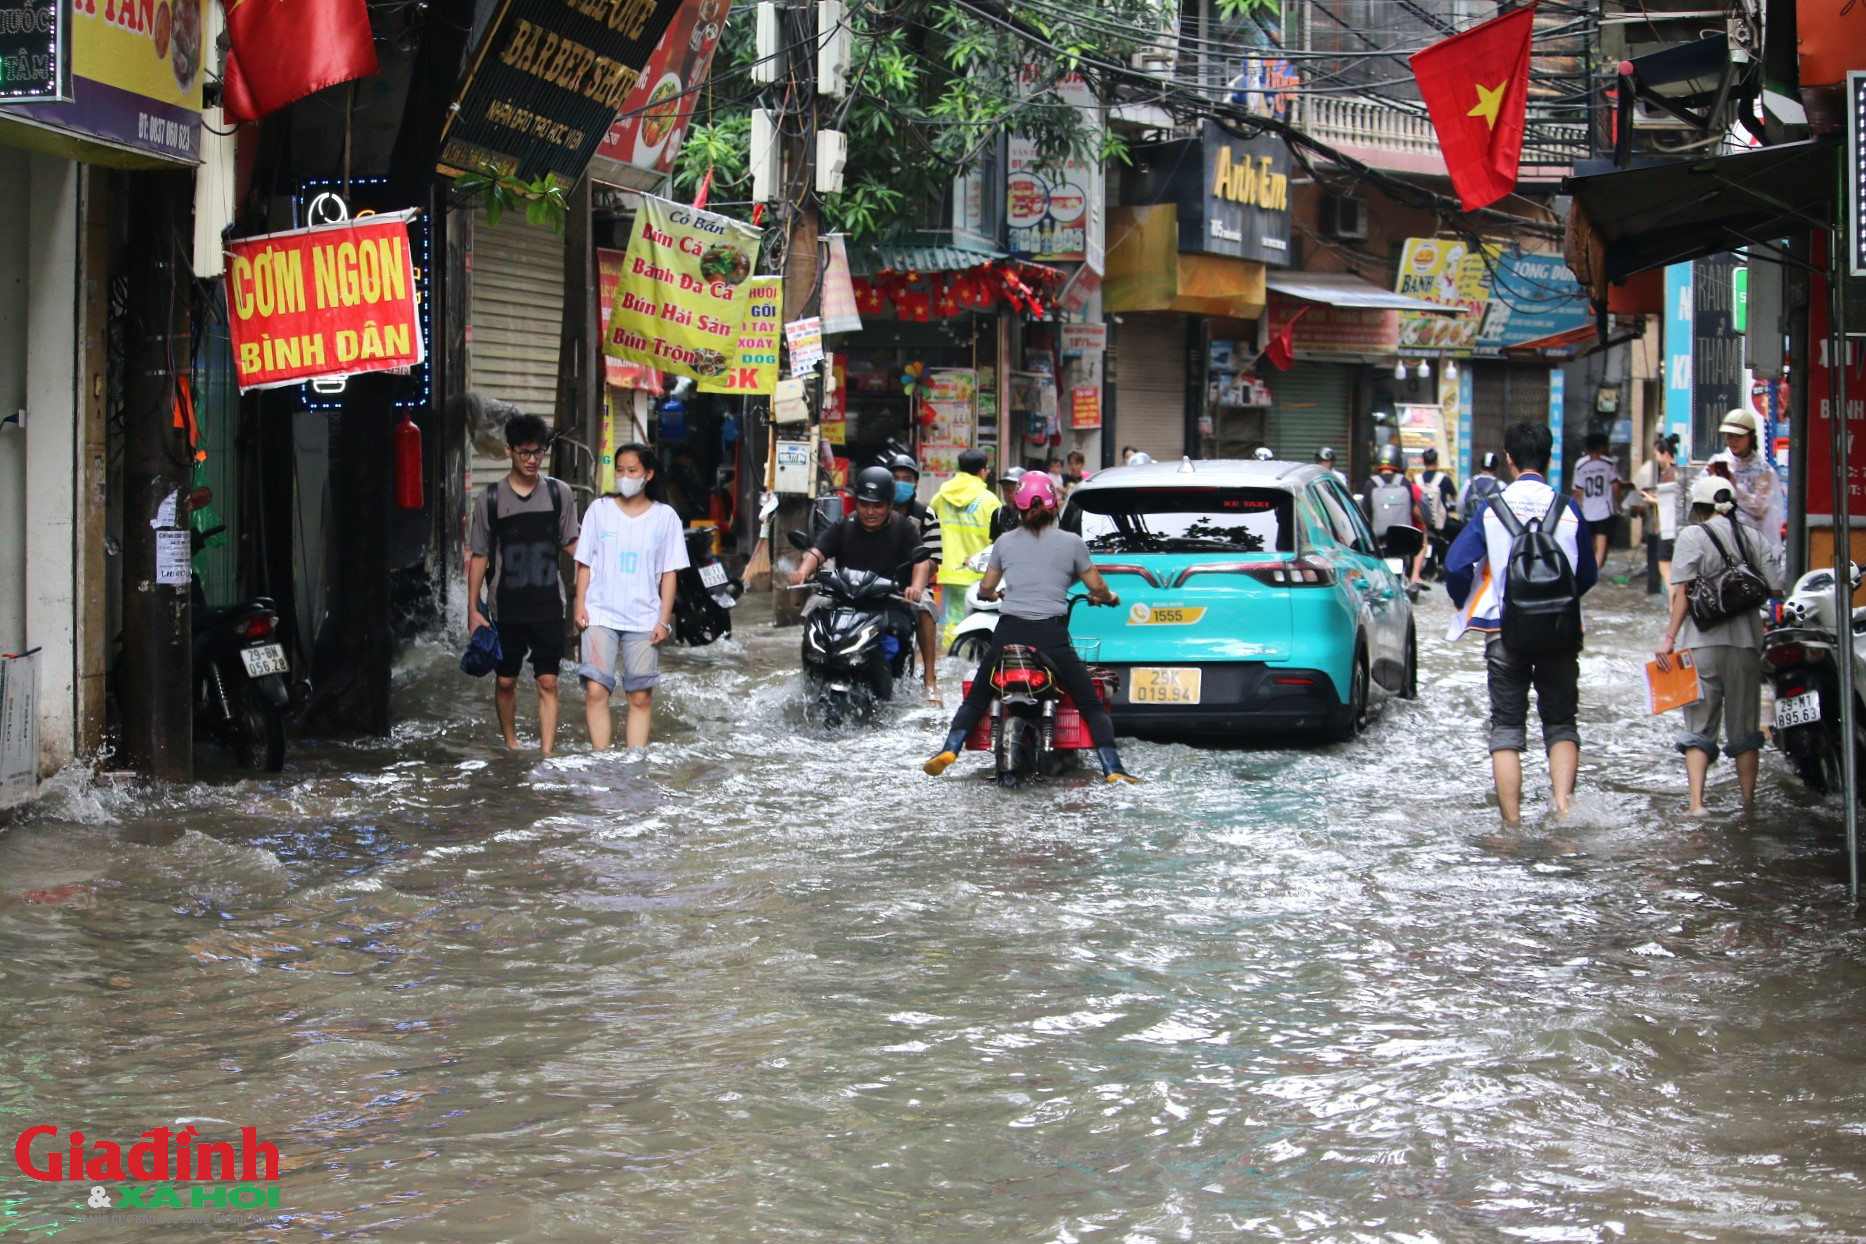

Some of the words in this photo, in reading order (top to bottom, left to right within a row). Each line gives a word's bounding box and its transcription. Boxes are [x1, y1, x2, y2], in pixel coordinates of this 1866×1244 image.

[4, 48, 49, 81] TÂM
[500, 18, 596, 92] BARBER
[1212, 146, 1256, 204] Anh
[1259, 156, 1288, 211] Em
[693, 216, 726, 236] Bán
[641, 222, 674, 249] Bún
[679, 236, 704, 257] Cá
[232, 246, 306, 320] CƠM
[312, 236, 406, 310] NGON
[632, 257, 675, 285] Bánh
[680, 273, 704, 294] Đa
[710, 281, 736, 301] Cá
[1401, 273, 1435, 294] BÁNH
[622, 292, 657, 317] Bún
[661, 303, 692, 327] Hải
[697, 314, 732, 337] Sản
[751, 302, 777, 318] GỐI
[751, 321, 776, 333] TÂY
[239, 333, 326, 375] BÌNH
[335, 320, 411, 362] DÂN
[613, 327, 647, 351] Bún
[653, 337, 696, 365] Trộn
[742, 354, 776, 364] DOG
[1585, 475, 1605, 498] 09
[619, 551, 638, 574] 10
[1153, 610, 1183, 622] 1555
[249, 658, 286, 675] 056.28
[1137, 687, 1191, 701] 019.94
[1779, 707, 1817, 727] 895.63
